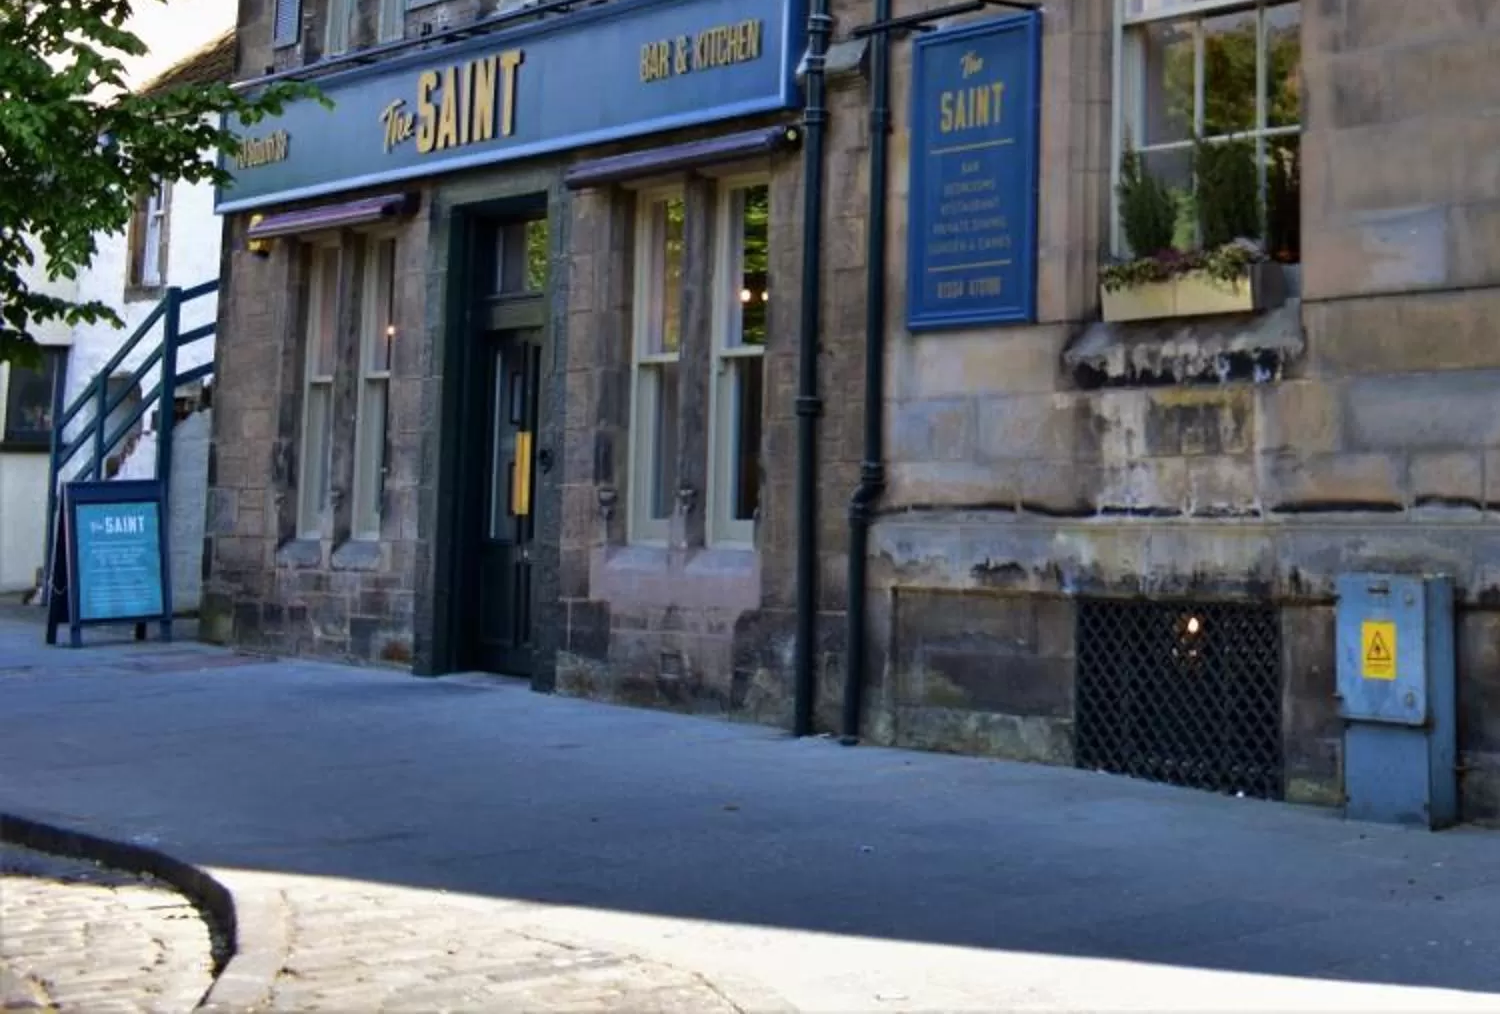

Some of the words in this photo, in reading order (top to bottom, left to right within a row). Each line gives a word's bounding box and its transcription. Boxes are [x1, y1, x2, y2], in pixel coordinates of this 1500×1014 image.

[640, 40, 669, 82] BAR
[674, 34, 689, 74] &
[693, 18, 761, 71] KITCHEN
[379, 98, 415, 154] The
[416, 48, 523, 154] SAINT
[940, 82, 1005, 134] SAINT
[105, 514, 145, 534] SAINT
